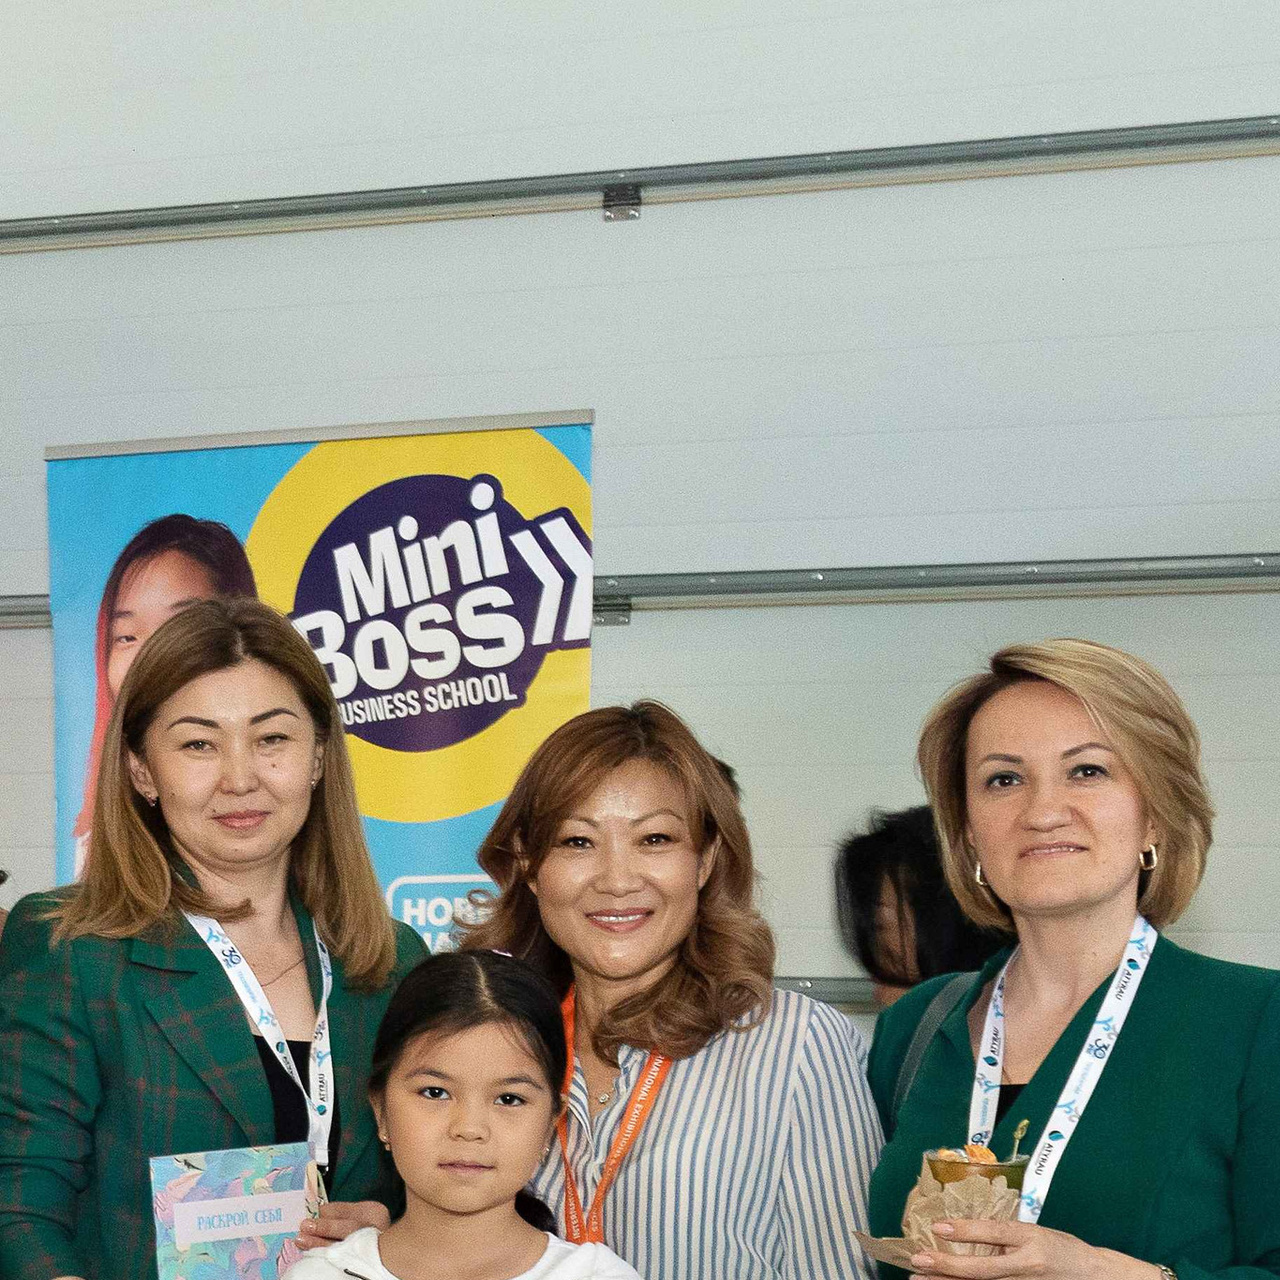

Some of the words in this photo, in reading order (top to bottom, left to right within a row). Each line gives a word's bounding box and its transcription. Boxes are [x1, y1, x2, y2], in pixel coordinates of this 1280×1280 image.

[332, 482, 509, 624] Mini
[338, 690, 421, 726] USINESS
[423, 672, 518, 713] SCHOOL
[637, 1056, 665, 1102] NATIONAL
[197, 1209, 249, 1230] РАСКРОЙ
[254, 1207, 283, 1224] СЕБЯ
